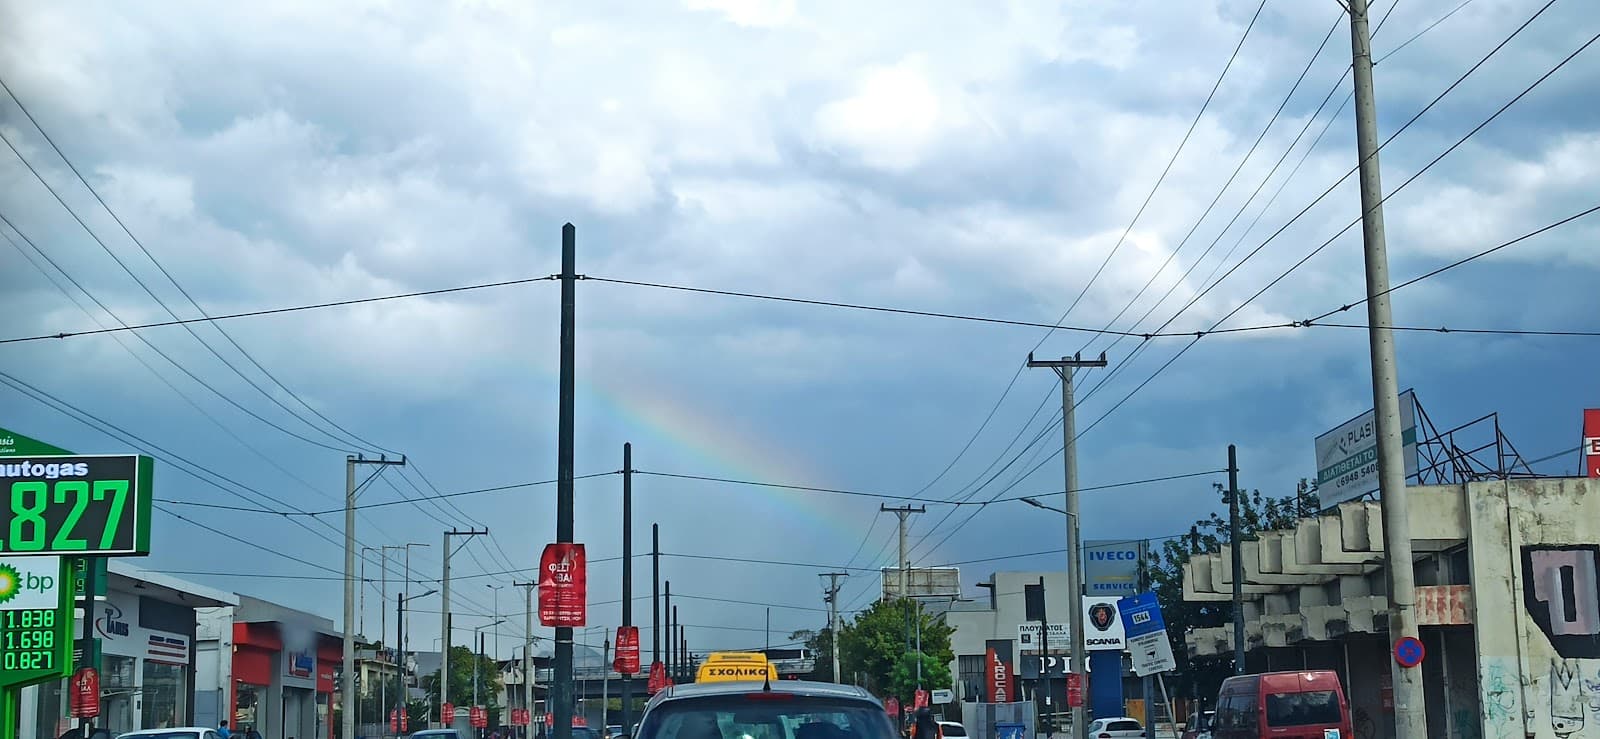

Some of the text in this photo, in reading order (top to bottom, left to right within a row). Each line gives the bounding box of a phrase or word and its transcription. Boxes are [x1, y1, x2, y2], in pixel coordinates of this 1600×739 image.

[1089, 551, 1136, 561] IVECO
[26, 571, 54, 594] bp
[6, 610, 54, 629] 1.838
[5, 630, 54, 649] 1.698
[1086, 638, 1121, 646] SCANIA
[5, 651, 52, 669] 0.827
[709, 668, 768, 676] ΣΧΟΛΙΚΟ
